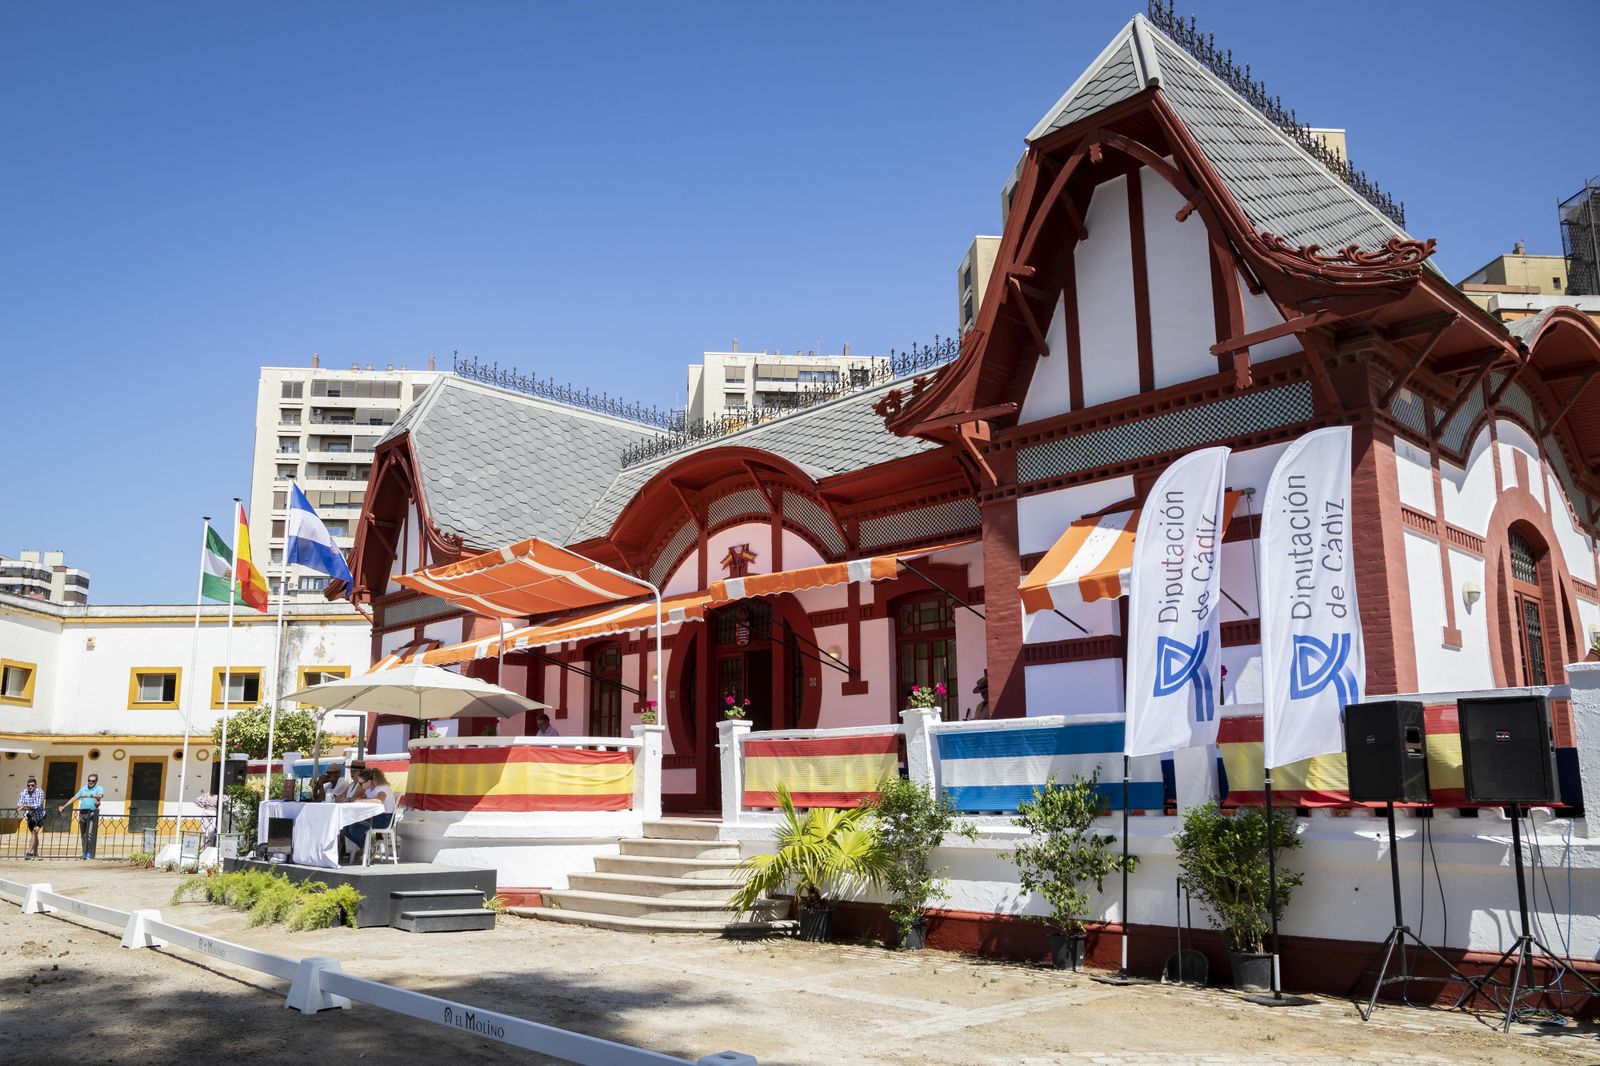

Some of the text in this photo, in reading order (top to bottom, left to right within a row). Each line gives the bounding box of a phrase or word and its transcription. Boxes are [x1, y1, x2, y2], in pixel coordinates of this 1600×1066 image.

[1158, 491, 1184, 623] Diputación
[1191, 514, 1217, 621] de Cádiz
[1283, 475, 1315, 620] Diputación
[1321, 498, 1347, 619] de Cádiz
[455, 1015, 463, 1028] EL
